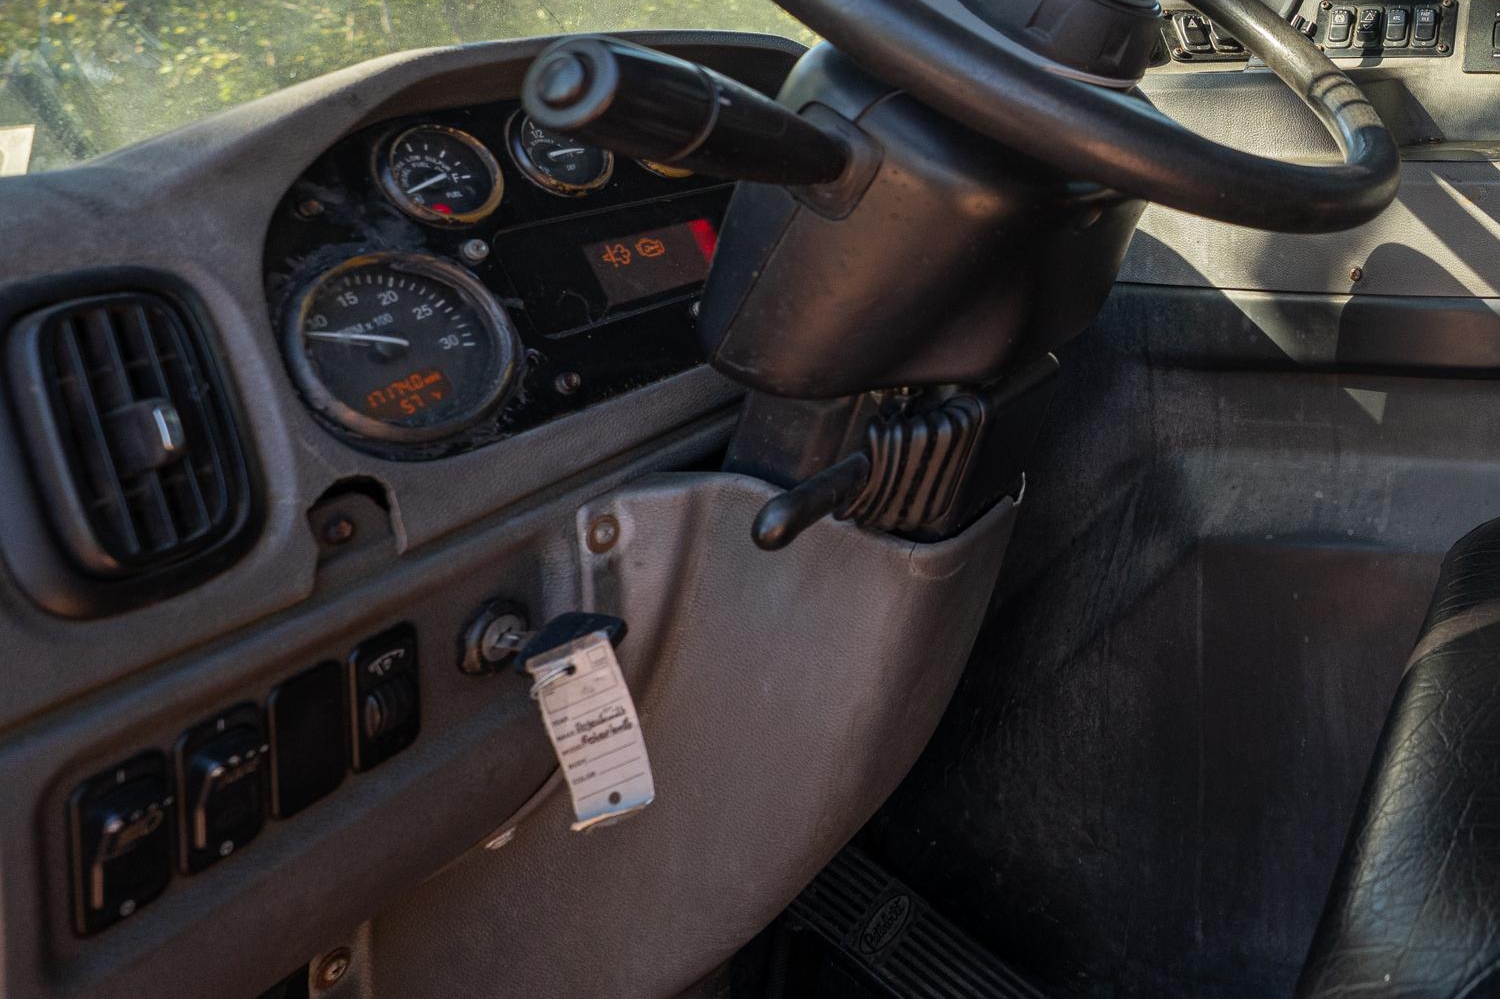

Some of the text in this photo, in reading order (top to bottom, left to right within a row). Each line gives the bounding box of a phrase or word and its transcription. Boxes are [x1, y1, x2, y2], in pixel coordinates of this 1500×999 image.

[530, 129, 545, 139] 1/2
[446, 191, 463, 199] FUEL
[336, 291, 359, 308] 15
[377, 290, 399, 306] 20
[373, 313, 393, 326] 100
[412, 305, 433, 320] 25
[438, 334, 460, 350] 30
